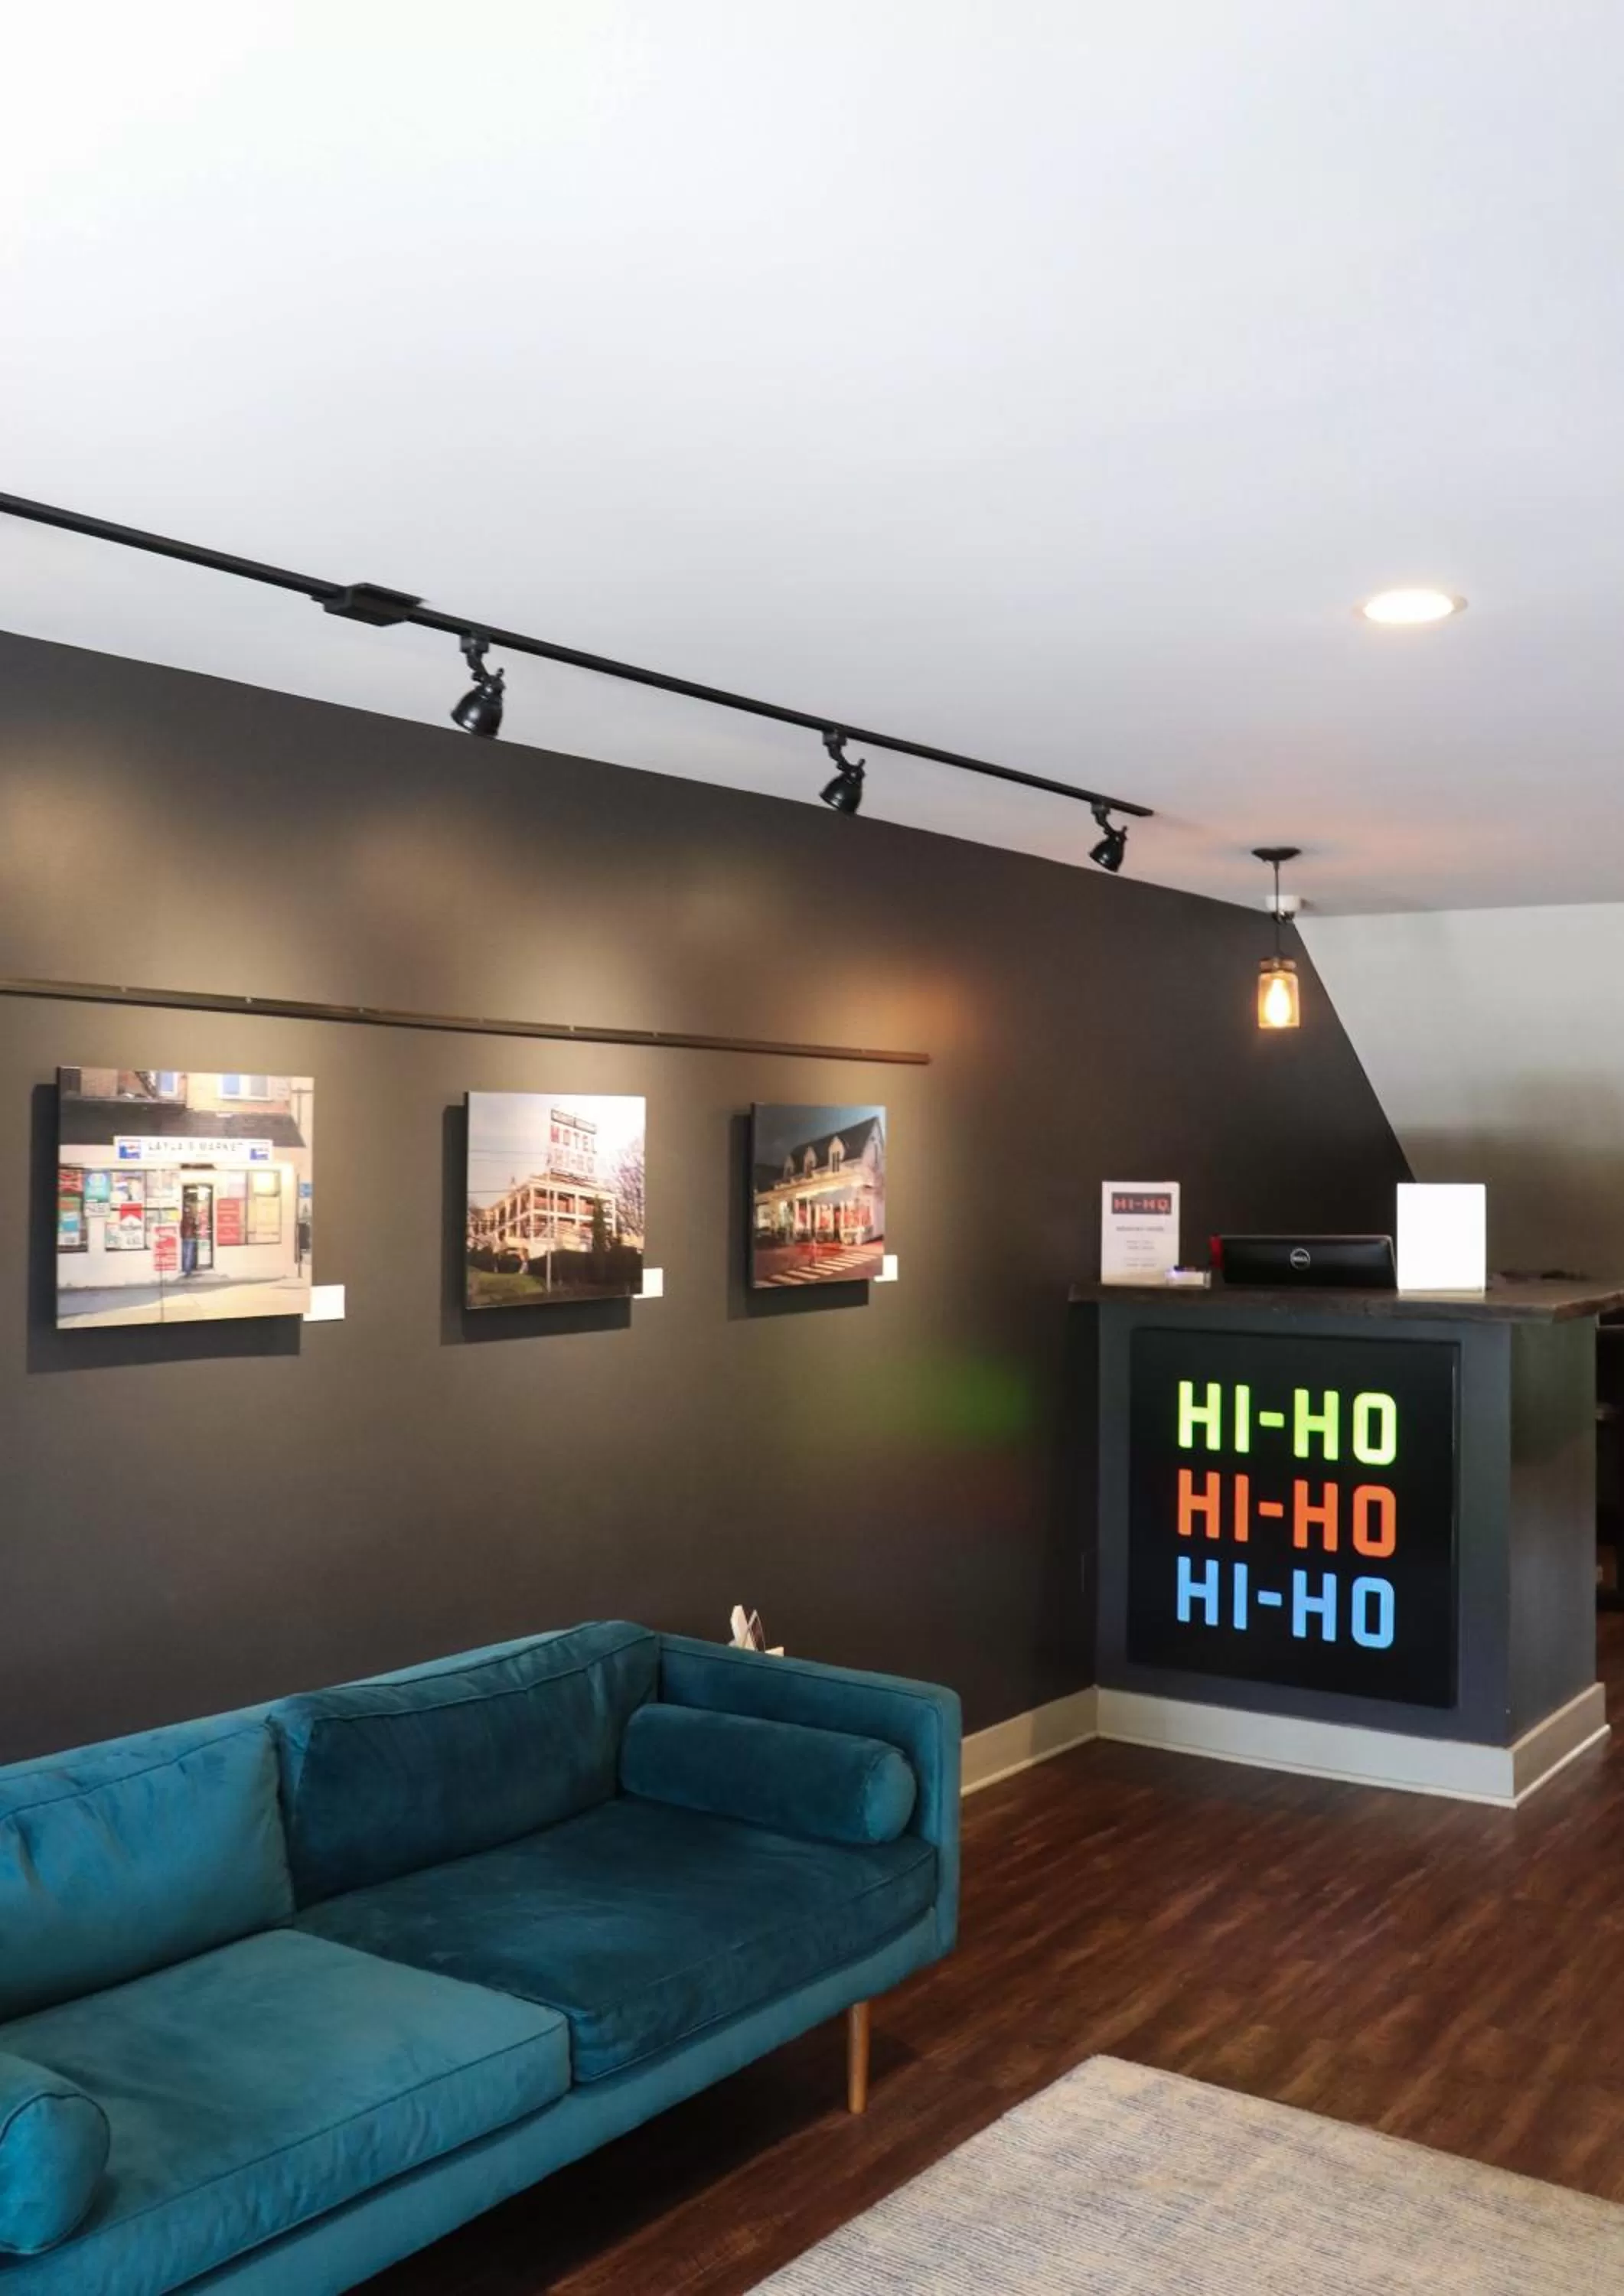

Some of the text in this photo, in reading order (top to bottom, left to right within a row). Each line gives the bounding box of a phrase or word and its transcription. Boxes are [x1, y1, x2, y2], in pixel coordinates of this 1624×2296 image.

[1114, 1198, 1169, 1212] HI-HO
[1178, 1380, 1397, 1466] HI-HO
[1178, 1469, 1397, 1557] HI-HO
[1177, 1556, 1394, 1649] HI-HO
